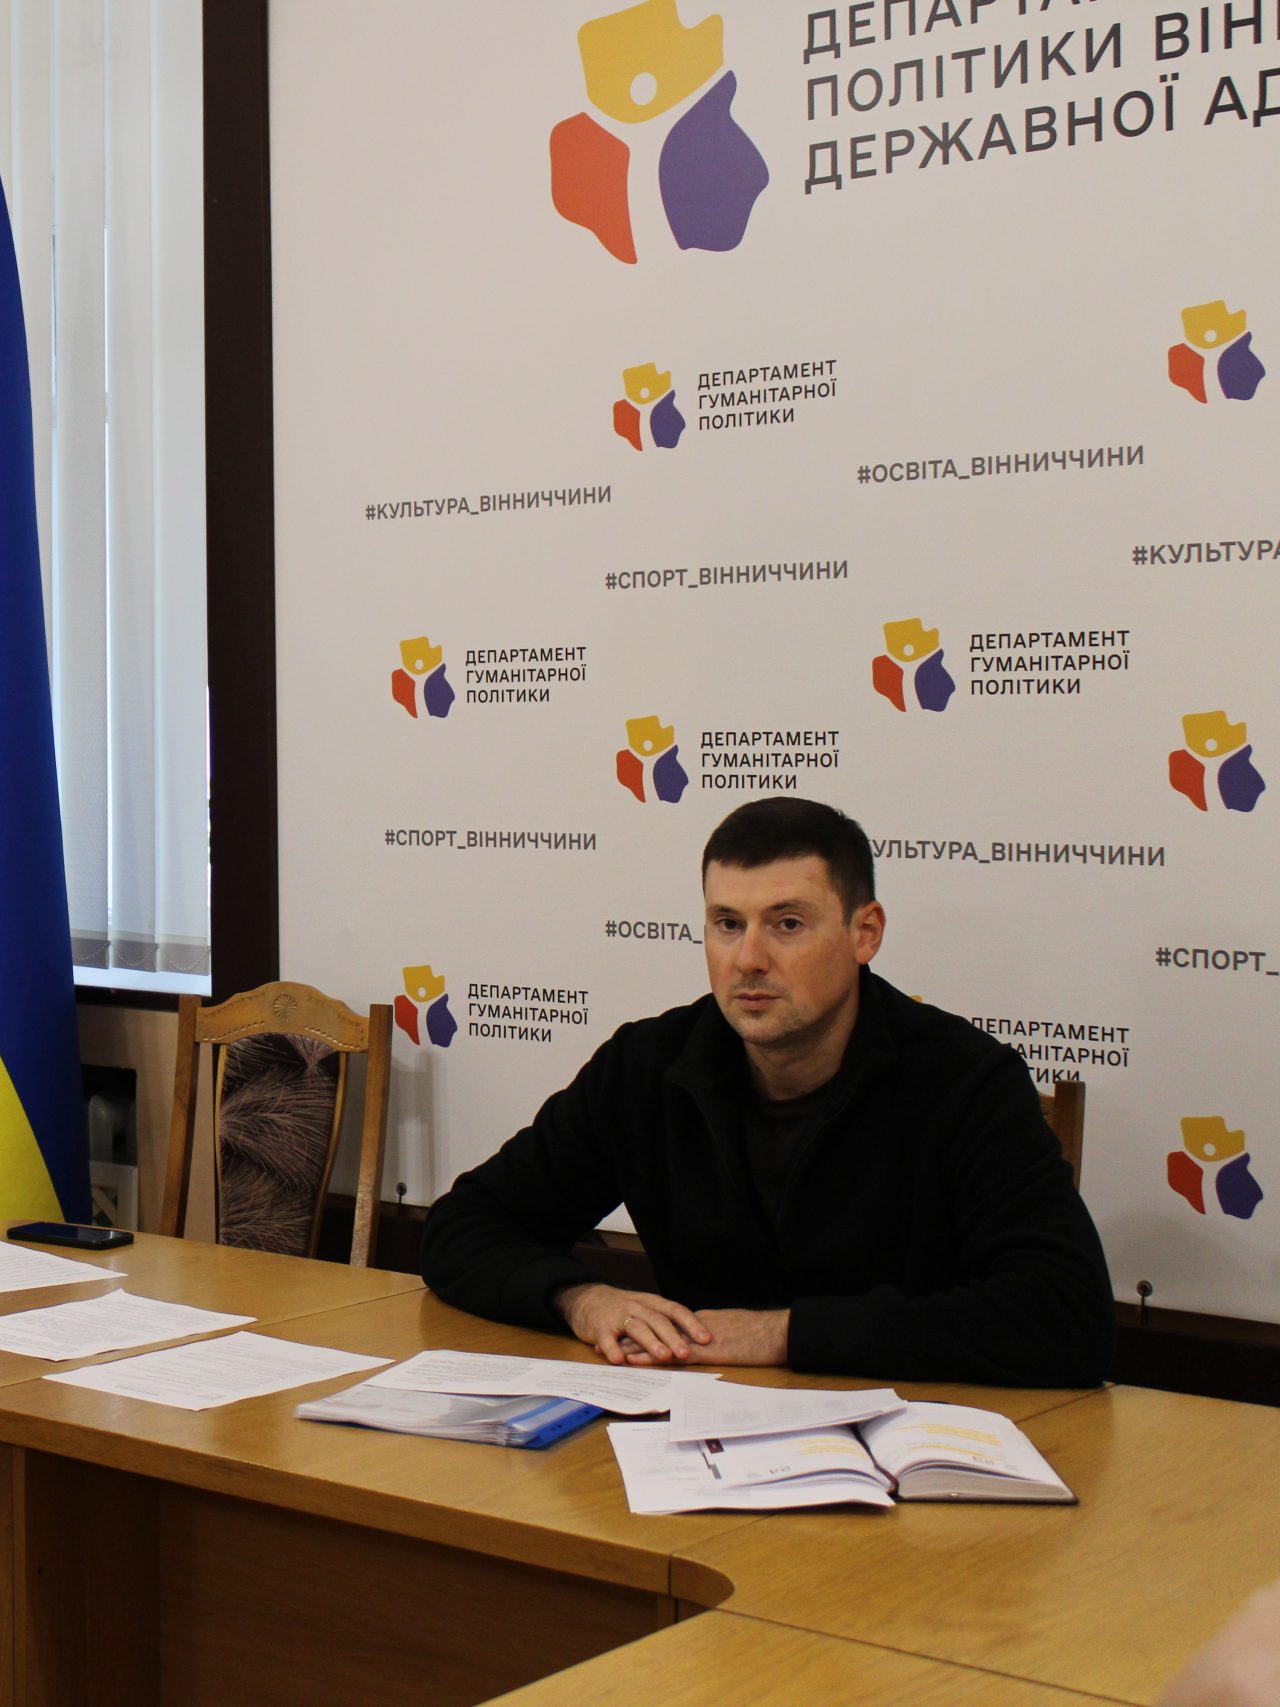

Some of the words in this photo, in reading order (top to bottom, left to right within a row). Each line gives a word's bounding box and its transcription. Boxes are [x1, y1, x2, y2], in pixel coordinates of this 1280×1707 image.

[804, 0, 1096, 64] ДЕПАР
[808, 23, 1121, 120] ПОЛІТИКИ
[1156, 0, 1280, 61] ВІН
[805, 72, 1179, 195] ДЕРЖАВНОЇ
[1204, 68, 1280, 127] АД
[698, 360, 836, 391] ДЕПАРТАМЕНТ
[699, 378, 836, 409] ГУМАНІТАРНОЇ
[700, 408, 793, 430] ПОЛІТИКИ
[858, 445, 1143, 483] #ОСВІТА_ВІННИЧЧИНИ
[366, 486, 610, 520] #КУЛЬТУРА_ВІННИЧЧИНИ
[606, 560, 847, 589] #СПОРТ_ВІННИЧЧИНИ
[970, 631, 1130, 652] ДЕПАРТАМЕНТ
[466, 647, 586, 666] ДЕПАРТАМЕНТ
[971, 650, 1130, 672] ГУМАНІТАРНОЇ
[467, 664, 586, 683] ГУМАНІТАРНОЇ
[467, 689, 549, 703] ПОЛІТИКИ
[972, 679, 1080, 695] ПОЛІТИКИ
[701, 731, 839, 748] ДЕПАРТАМЕНТ
[702, 750, 839, 767] ГУМАНІТАРНОЇ
[702, 775, 796, 789] ПОЛІТИКИ
[385, 830, 596, 850] #СПОРТ_ВІННИЧЧИНИ
[869, 839, 1165, 867] УЛЬТУРА_ВІННИЧЧИНИ
[605, 920, 705, 945] #ОСВІТА_
[468, 984, 588, 1004] ДЕПАРТАМЕНТ
[469, 1003, 588, 1024] ГУМАНІТАРНОЇ
[469, 1024, 551, 1042] ПОЛІТИКИ
[1016, 1043, 1129, 1067] АНІТАРНОЇ
